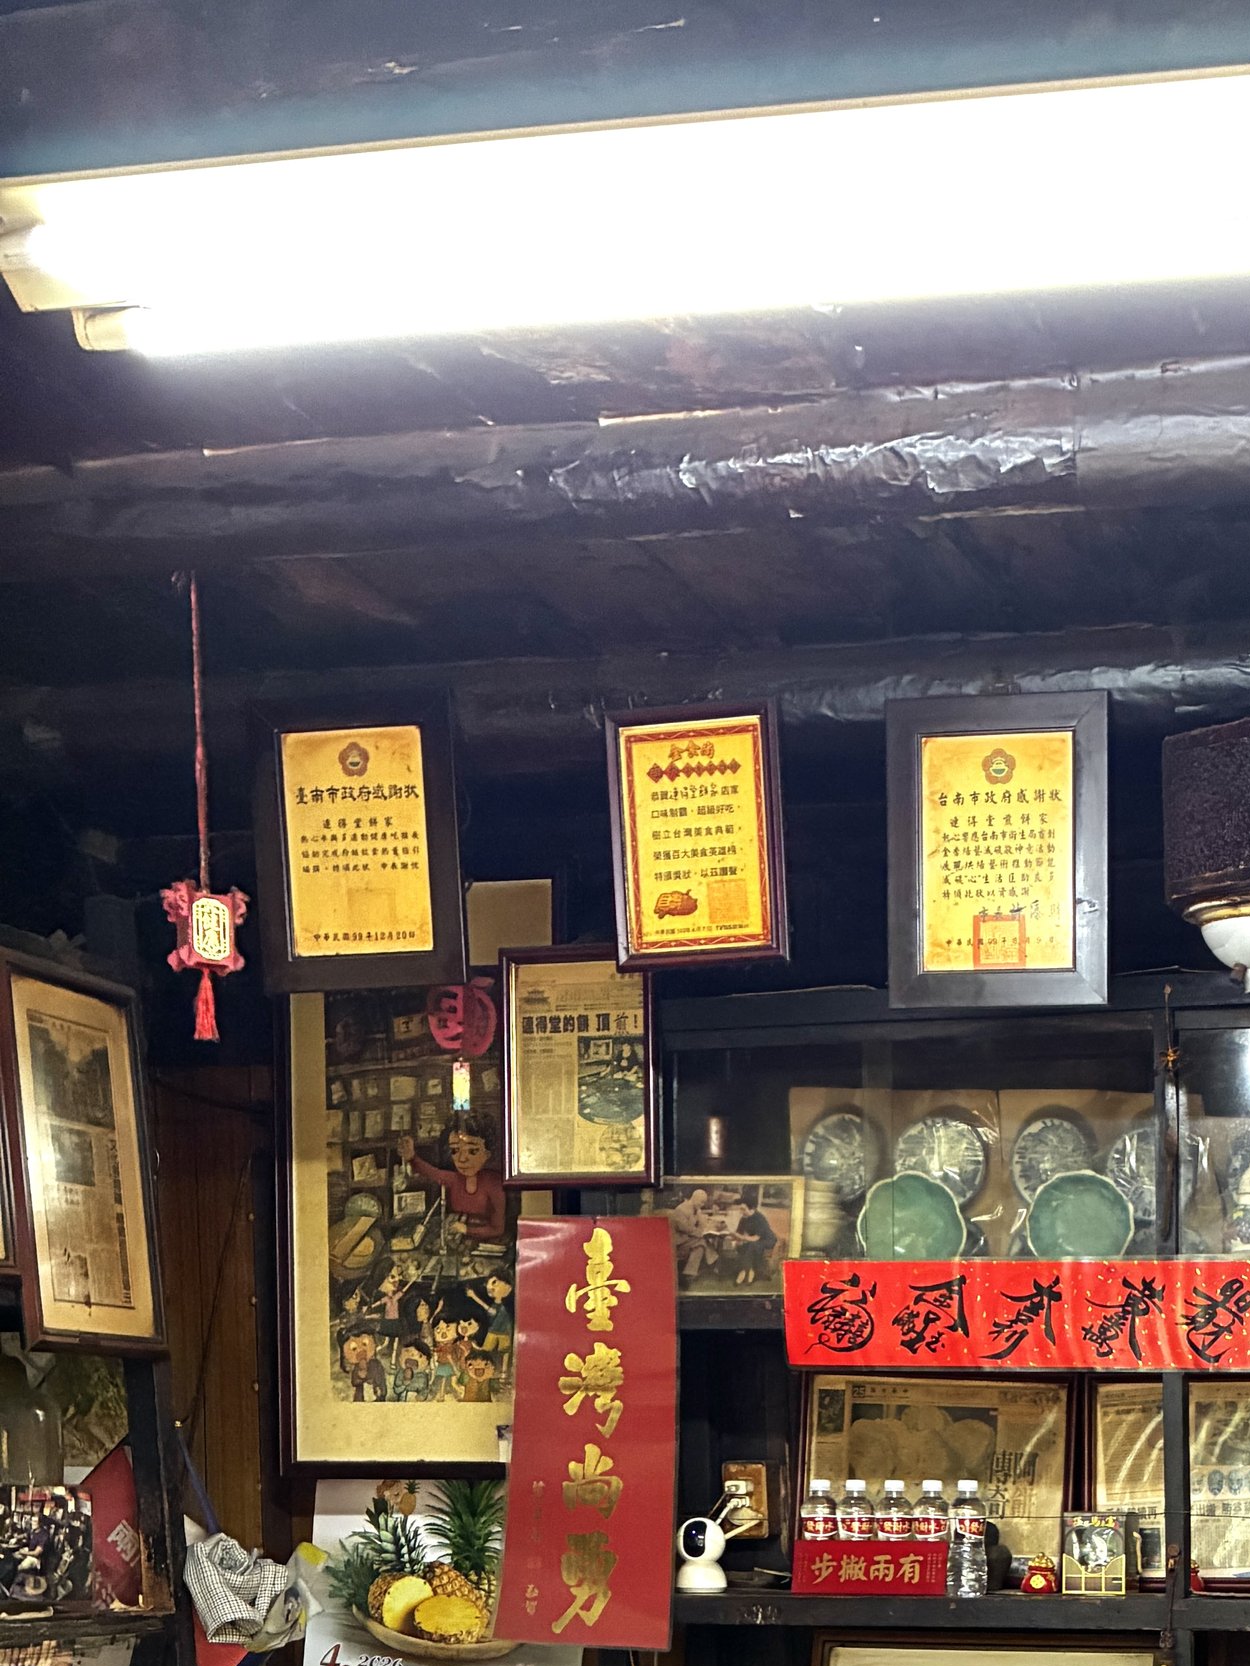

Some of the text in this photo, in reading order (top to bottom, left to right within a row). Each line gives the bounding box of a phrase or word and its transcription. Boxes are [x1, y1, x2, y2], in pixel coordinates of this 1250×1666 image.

[296, 784, 420, 805] 臺南市政府感謝狀
[938, 789, 1062, 807] 台南市政府感謝狀
[551, 1227, 632, 1635] 臺灣尚勇
